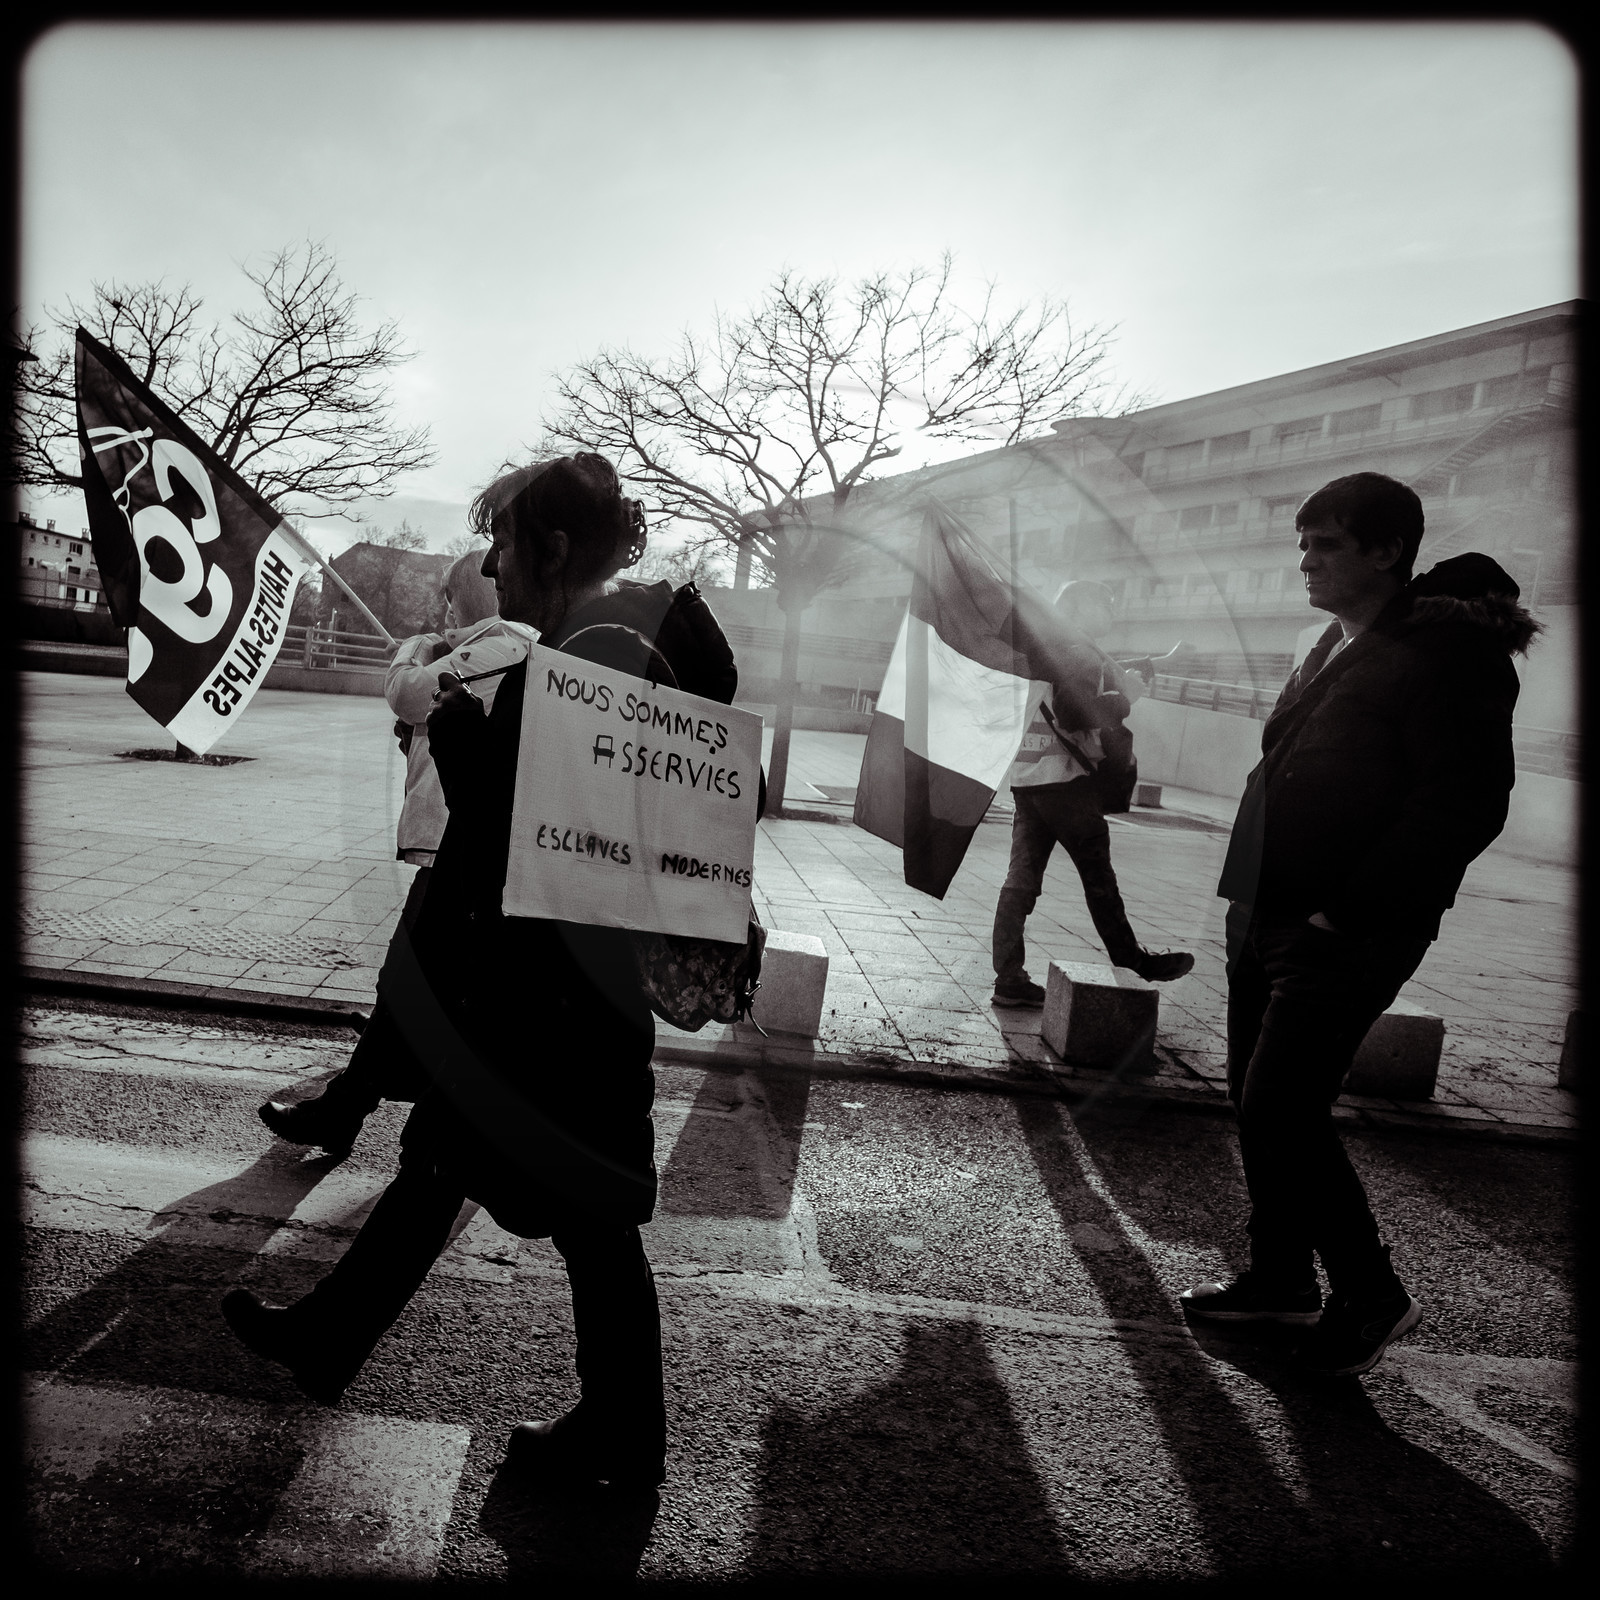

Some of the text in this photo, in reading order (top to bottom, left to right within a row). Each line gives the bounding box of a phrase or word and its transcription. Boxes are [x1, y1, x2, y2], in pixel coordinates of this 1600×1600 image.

[547, 669, 728, 749] NOUS SOMMES
[593, 735, 740, 798] ASSERVIES
[537, 824, 751, 887] ESCLAVES MODERNES
